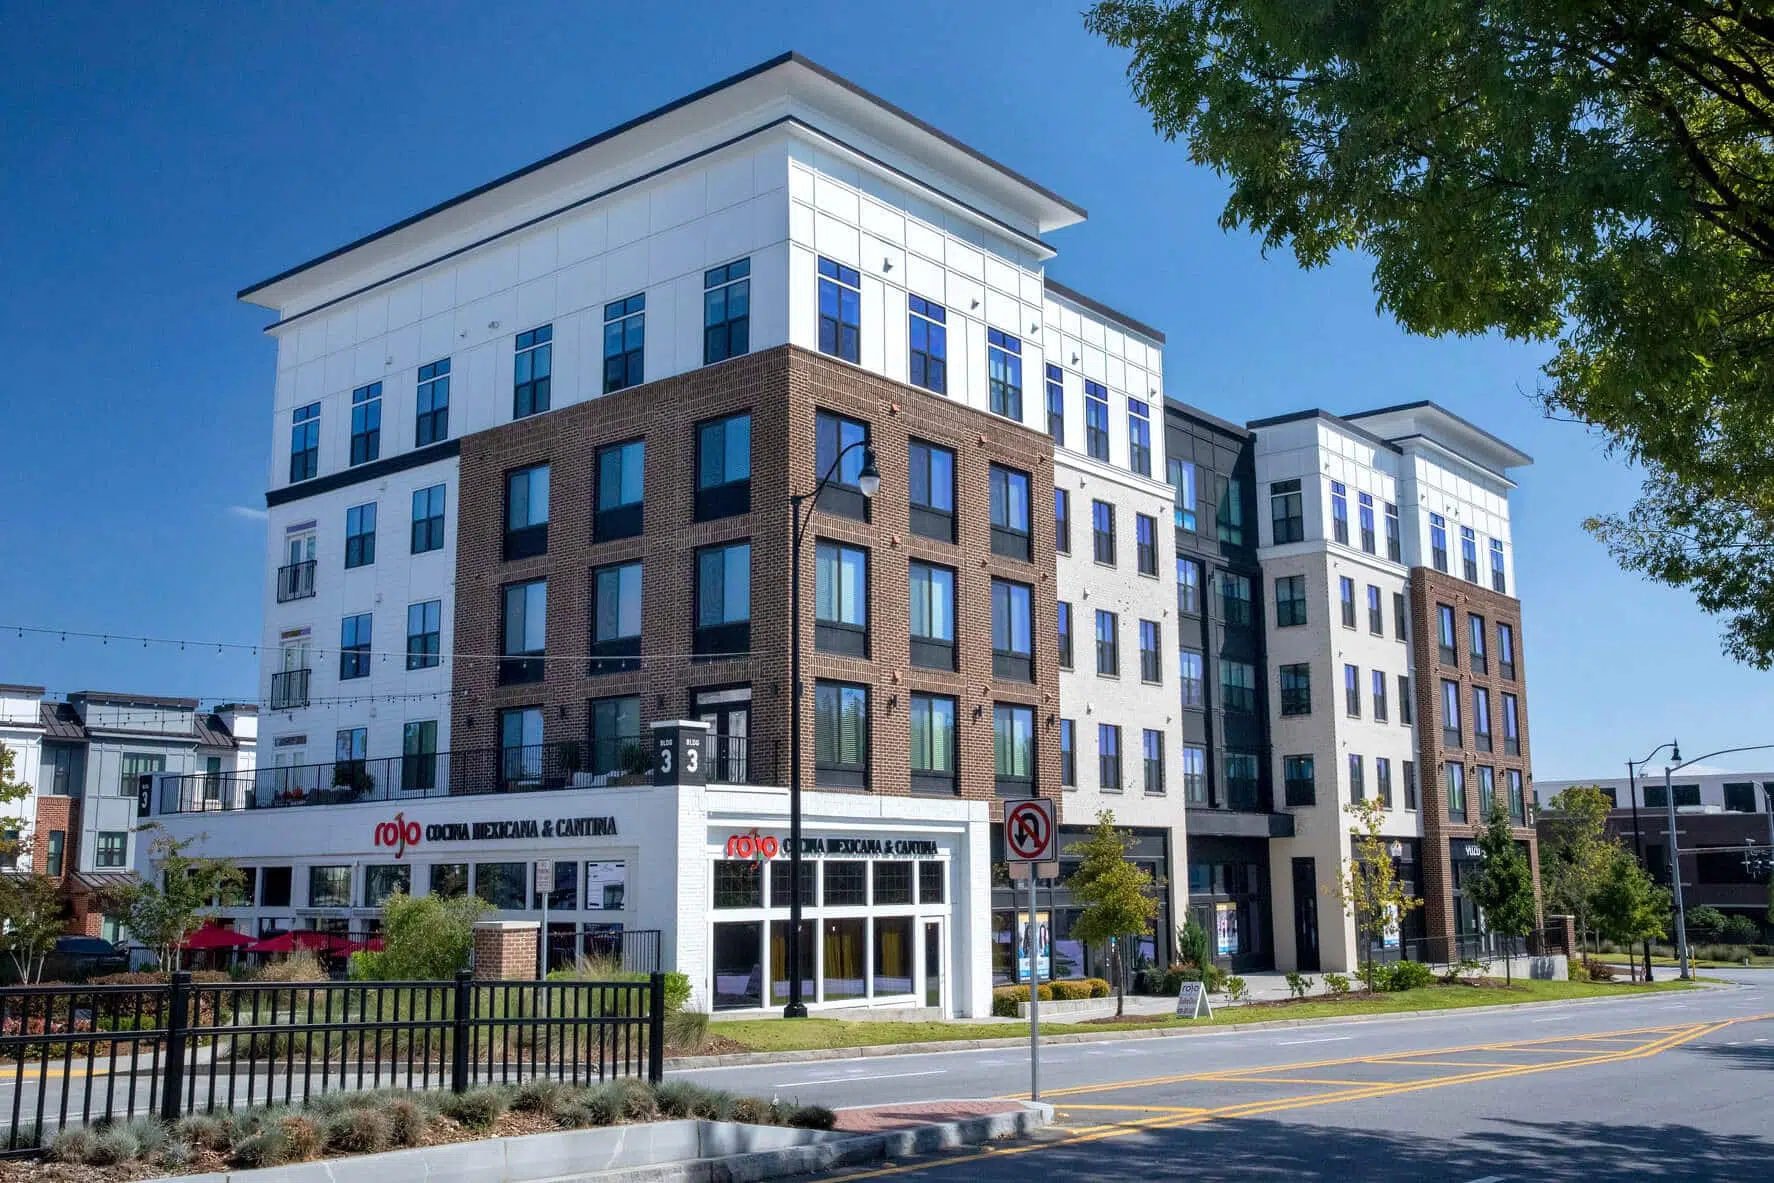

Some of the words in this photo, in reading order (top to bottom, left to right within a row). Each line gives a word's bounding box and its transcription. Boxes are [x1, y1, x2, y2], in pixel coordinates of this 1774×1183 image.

[686, 738, 700, 746] BLDG
[661, 749, 672, 773] 3
[686, 749, 698, 773] 3
[141, 791, 148, 809] 3
[374, 811, 422, 859] rojo
[426, 823, 470, 842] COCINA
[472, 820, 539, 840] MEXICANA
[541, 819, 554, 838] &
[555, 816, 618, 838] CANTINA
[782, 837, 825, 853] CCINA
[826, 838, 882, 854] MEXICANA
[884, 839, 894, 854] &
[895, 840, 938, 855] CANTINA
